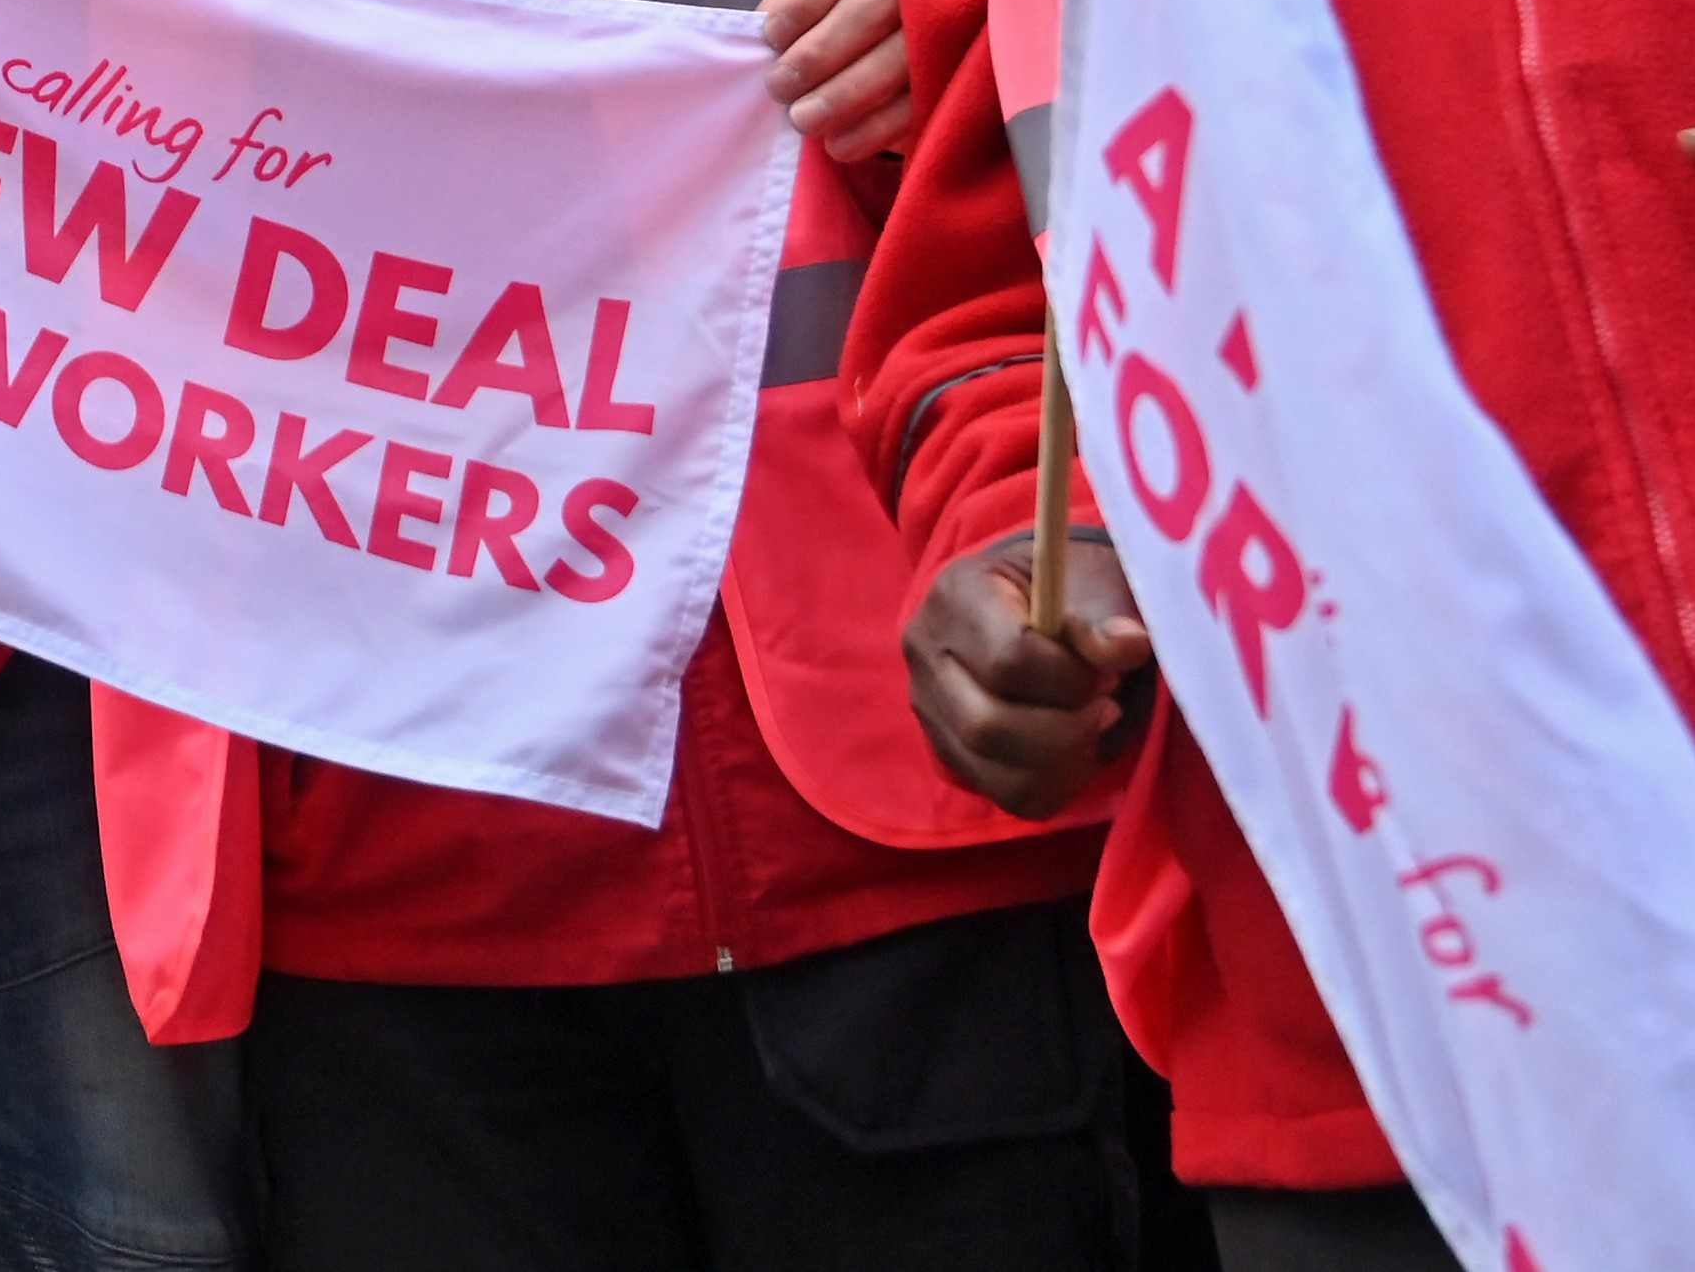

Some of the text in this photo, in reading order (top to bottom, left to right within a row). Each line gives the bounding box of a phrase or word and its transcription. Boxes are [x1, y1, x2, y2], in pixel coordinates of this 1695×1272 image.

[1, 57, 203, 183] calling
[211, 107, 332, 189] for
[1102, 84, 1196, 300] A
[223, 215, 656, 437] DEAL
[1075, 228, 1307, 723] FOR
